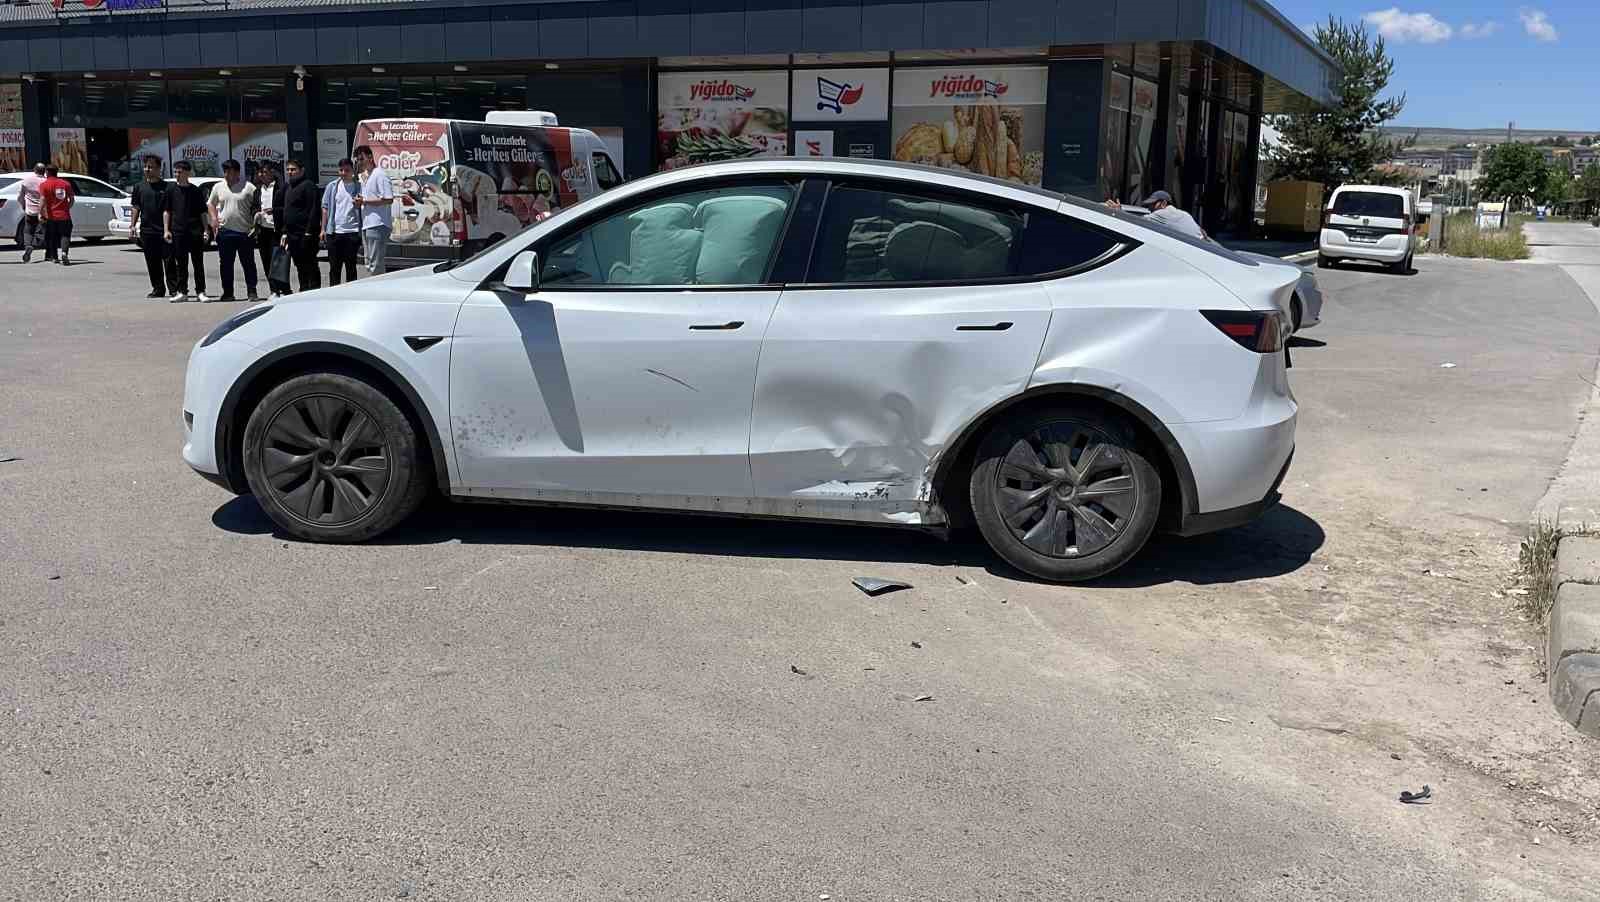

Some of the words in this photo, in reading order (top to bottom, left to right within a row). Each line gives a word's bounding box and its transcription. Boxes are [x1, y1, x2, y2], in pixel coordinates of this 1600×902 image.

[690, 80, 735, 100] yiğido
[930, 75, 984, 97] yiğido
[373, 131, 401, 141] Herkes
[402, 131, 427, 141] Güler
[481, 134, 491, 145] Bu
[474, 147, 510, 161] Herkes
[511, 148, 537, 162] Güler
[380, 155, 416, 169] Güler
